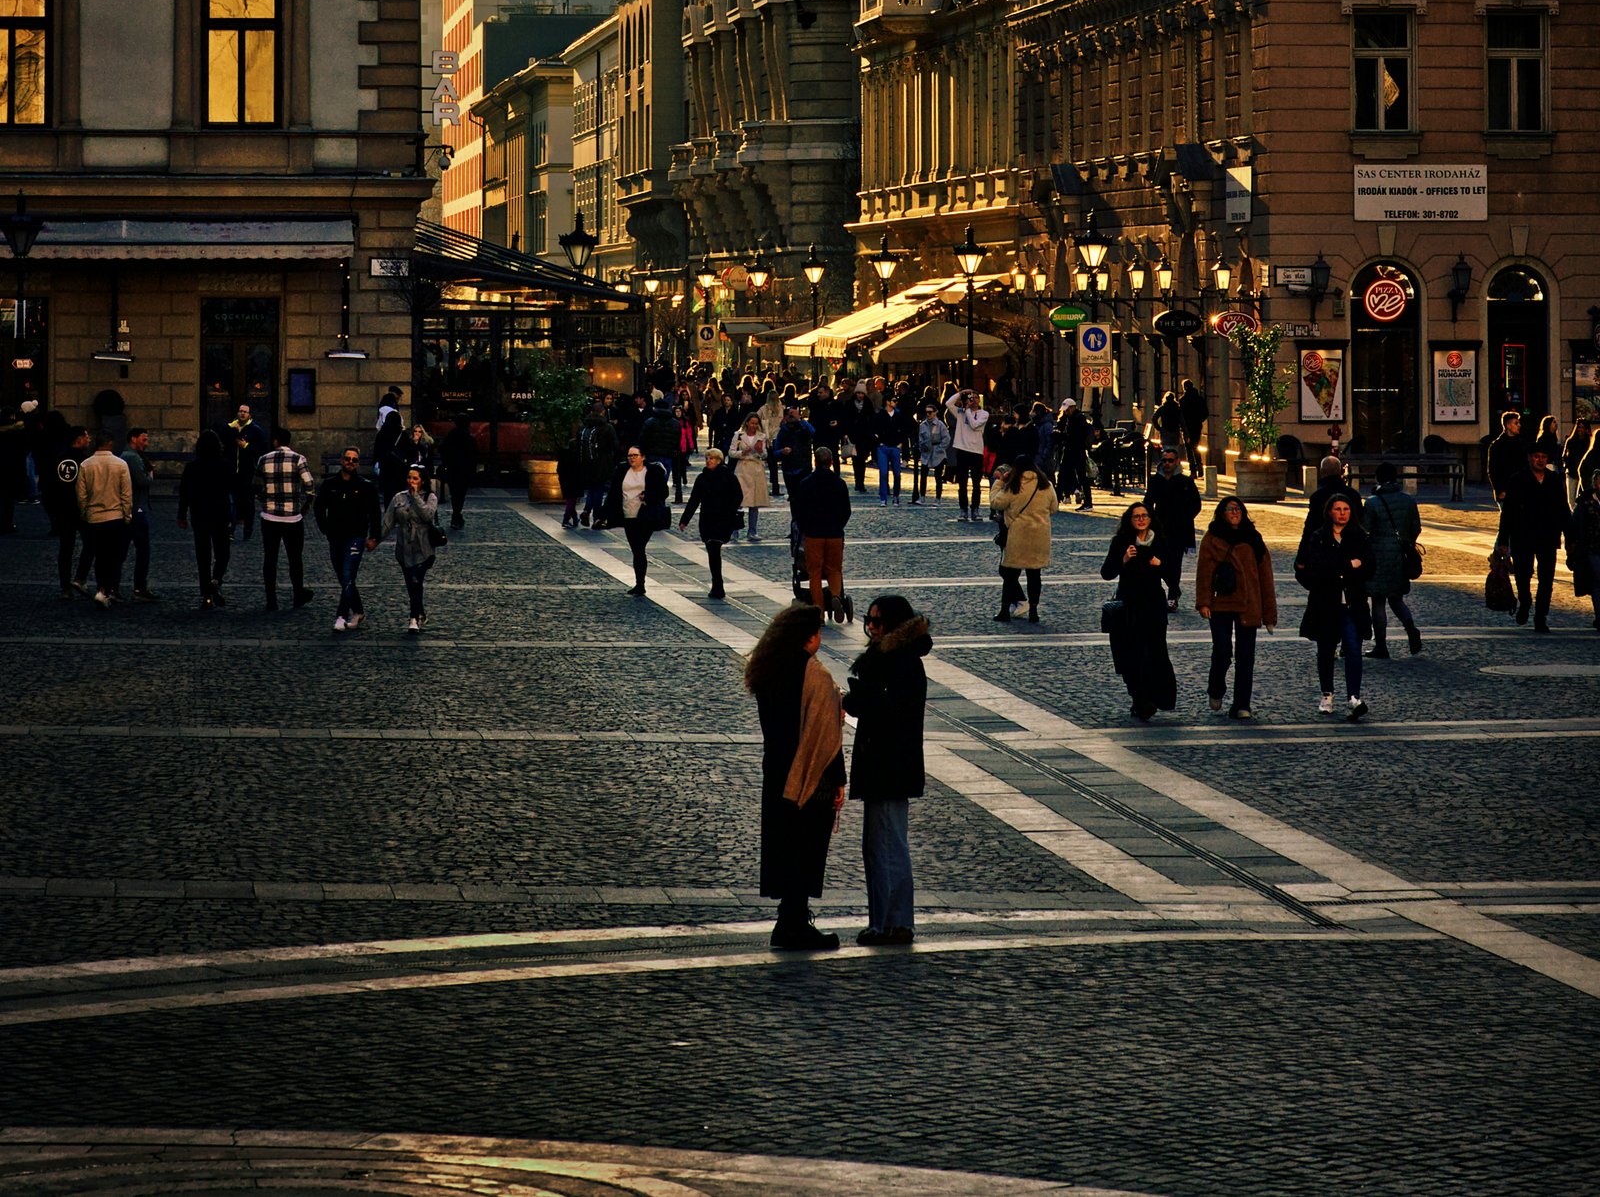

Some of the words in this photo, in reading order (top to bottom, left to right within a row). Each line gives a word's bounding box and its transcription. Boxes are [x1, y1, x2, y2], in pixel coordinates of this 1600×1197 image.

[431, 50, 461, 126] BAR
[1379, 169, 1421, 178] CENTER
[1425, 168, 1481, 178] IRODAHÁZ
[1358, 186, 1387, 195] IRODÁK
[1389, 186, 1418, 195] KIADÓK
[1426, 187, 1458, 195] OFFICES
[1460, 187, 1470, 195] TO
[1473, 186, 1486, 194] LET
[1384, 210, 1420, 219] TELEFON:
[1422, 210, 1459, 219] 301-8702
[1376, 286, 1400, 294] PIZZA
[1053, 313, 1085, 321] SUBWAY
